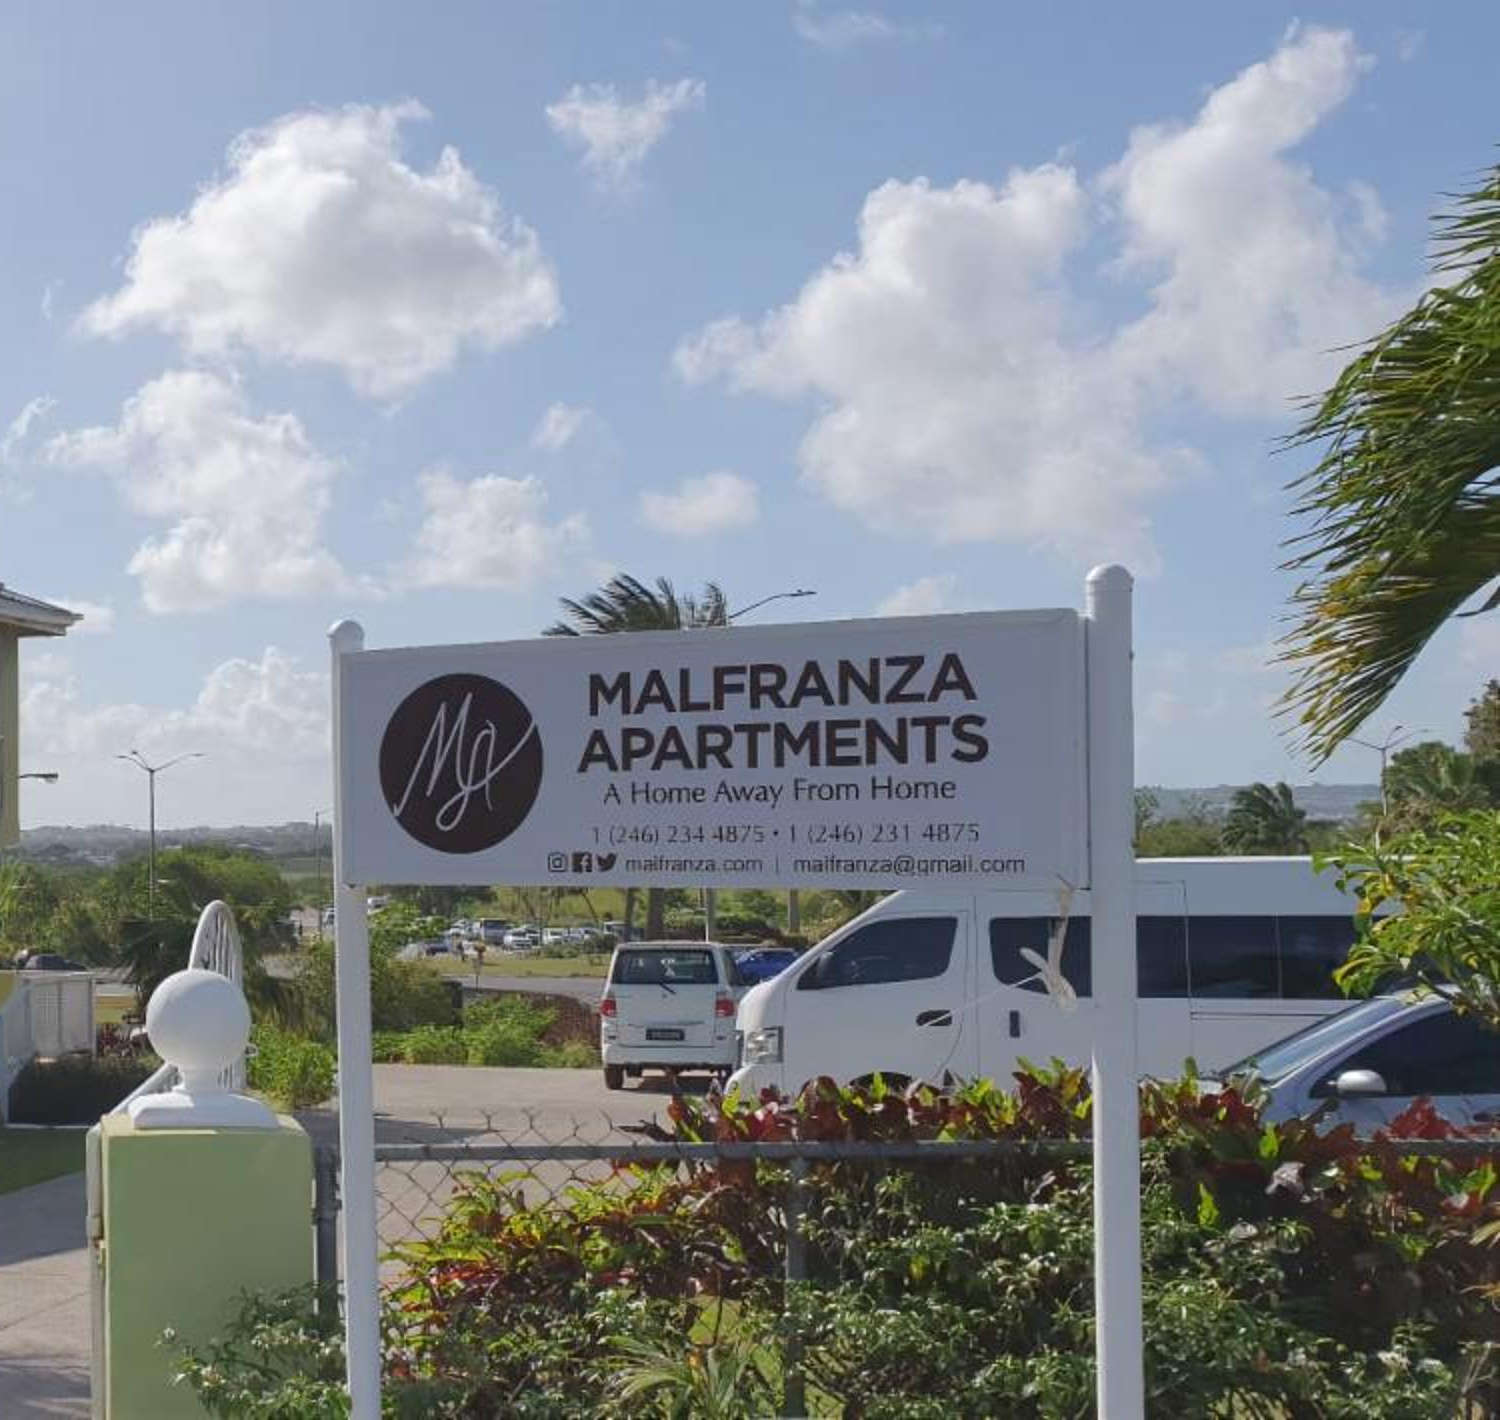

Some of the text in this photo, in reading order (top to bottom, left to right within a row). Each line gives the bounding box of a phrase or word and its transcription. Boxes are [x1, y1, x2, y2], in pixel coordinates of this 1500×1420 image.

[588, 653, 978, 717] MALFRANZA
[576, 714, 990, 773] APARTMENTS
[603, 775, 957, 810] A Home Away From Home
[609, 824, 660, 846] (246)
[667, 825, 705, 844] 234
[712, 824, 766, 844] 4875
[807, 823, 864, 845] (246)
[872, 823, 911, 844] 231
[922, 822, 981, 843] 4875
[625, 854, 1026, 877] malfranza.com malfranza@gmail.com
